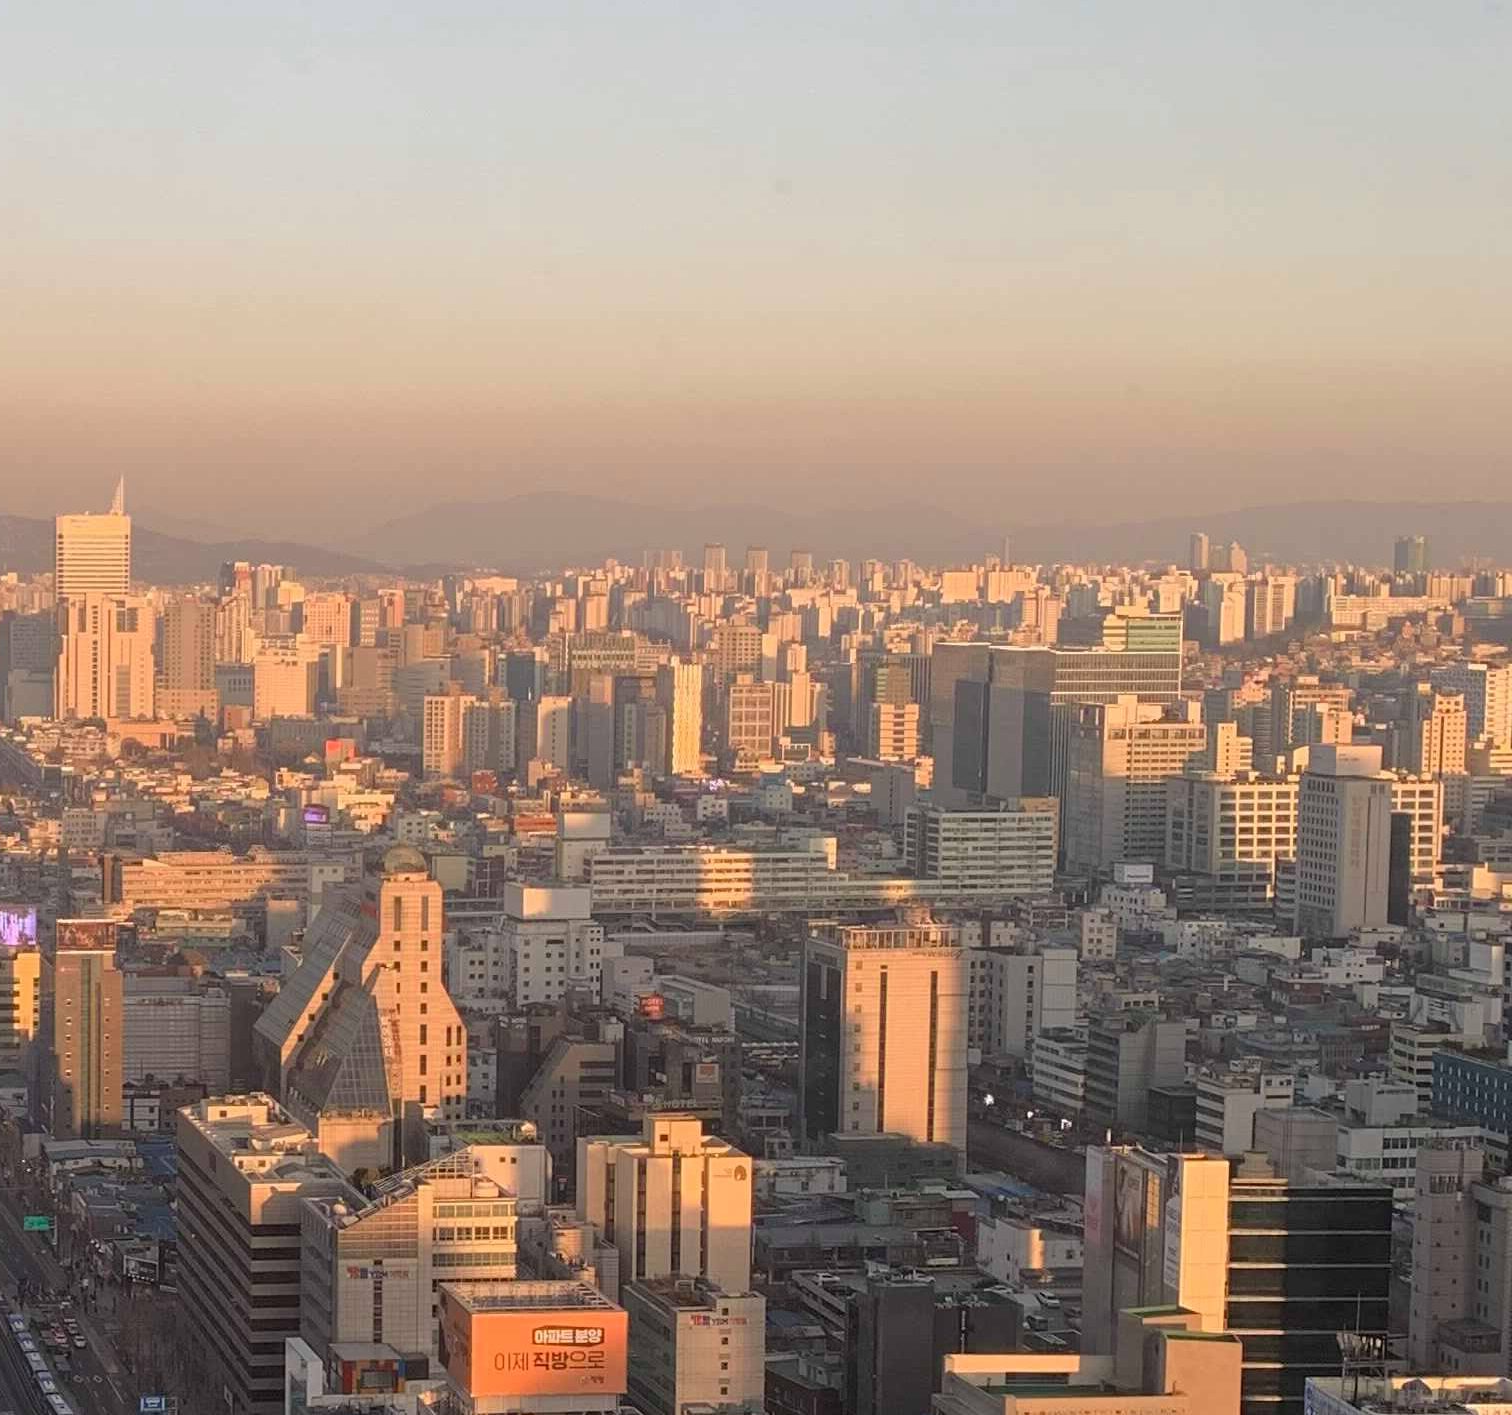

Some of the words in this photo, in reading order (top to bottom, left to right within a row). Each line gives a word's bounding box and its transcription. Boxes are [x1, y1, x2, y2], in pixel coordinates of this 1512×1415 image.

[534, 1329, 574, 1344] 아파트
[575, 1328, 602, 1344] 분양
[494, 1351, 529, 1371] 이제
[533, 1350, 605, 1371] 직방으로
